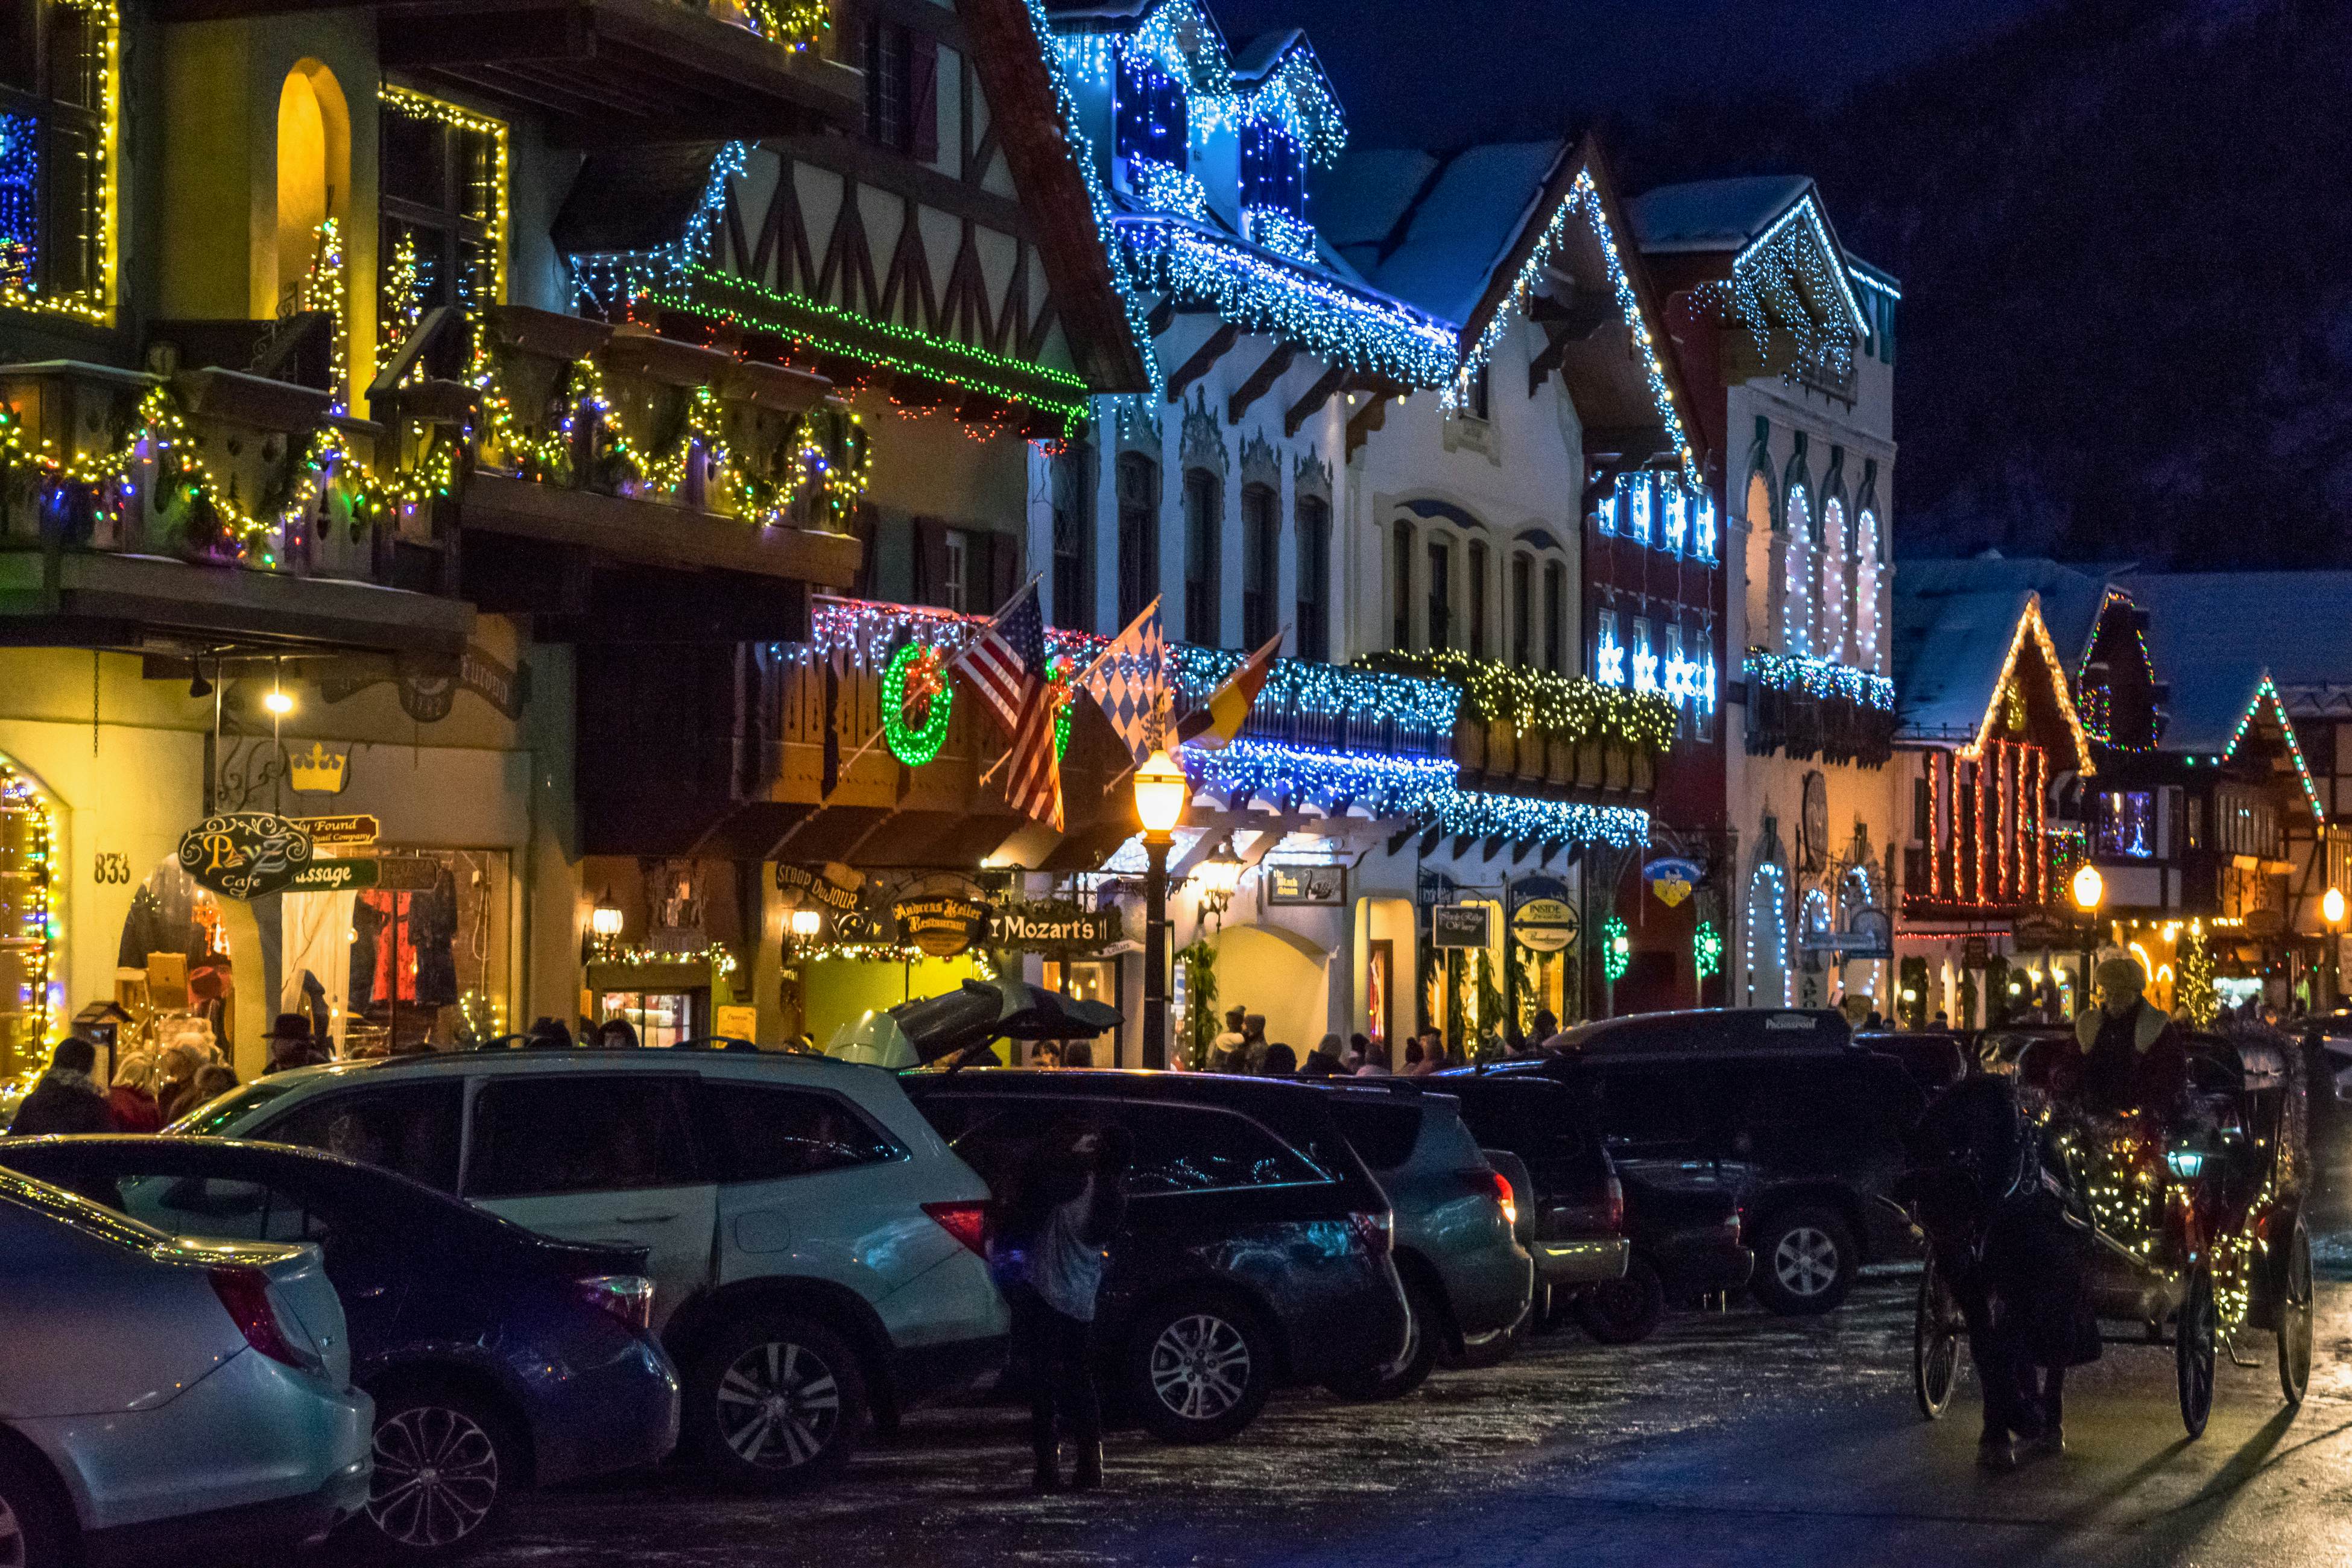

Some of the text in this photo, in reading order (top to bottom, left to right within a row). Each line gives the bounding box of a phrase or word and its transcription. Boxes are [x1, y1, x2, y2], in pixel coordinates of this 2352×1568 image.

[314, 818, 359, 832] Found
[333, 833, 370, 843] Company
[94, 853, 130, 885] 833
[295, 866, 352, 888] assage
[221, 873, 261, 896] Cafe
[1529, 905, 1561, 914] INSIDE
[1004, 915, 1095, 943] Mozart's
